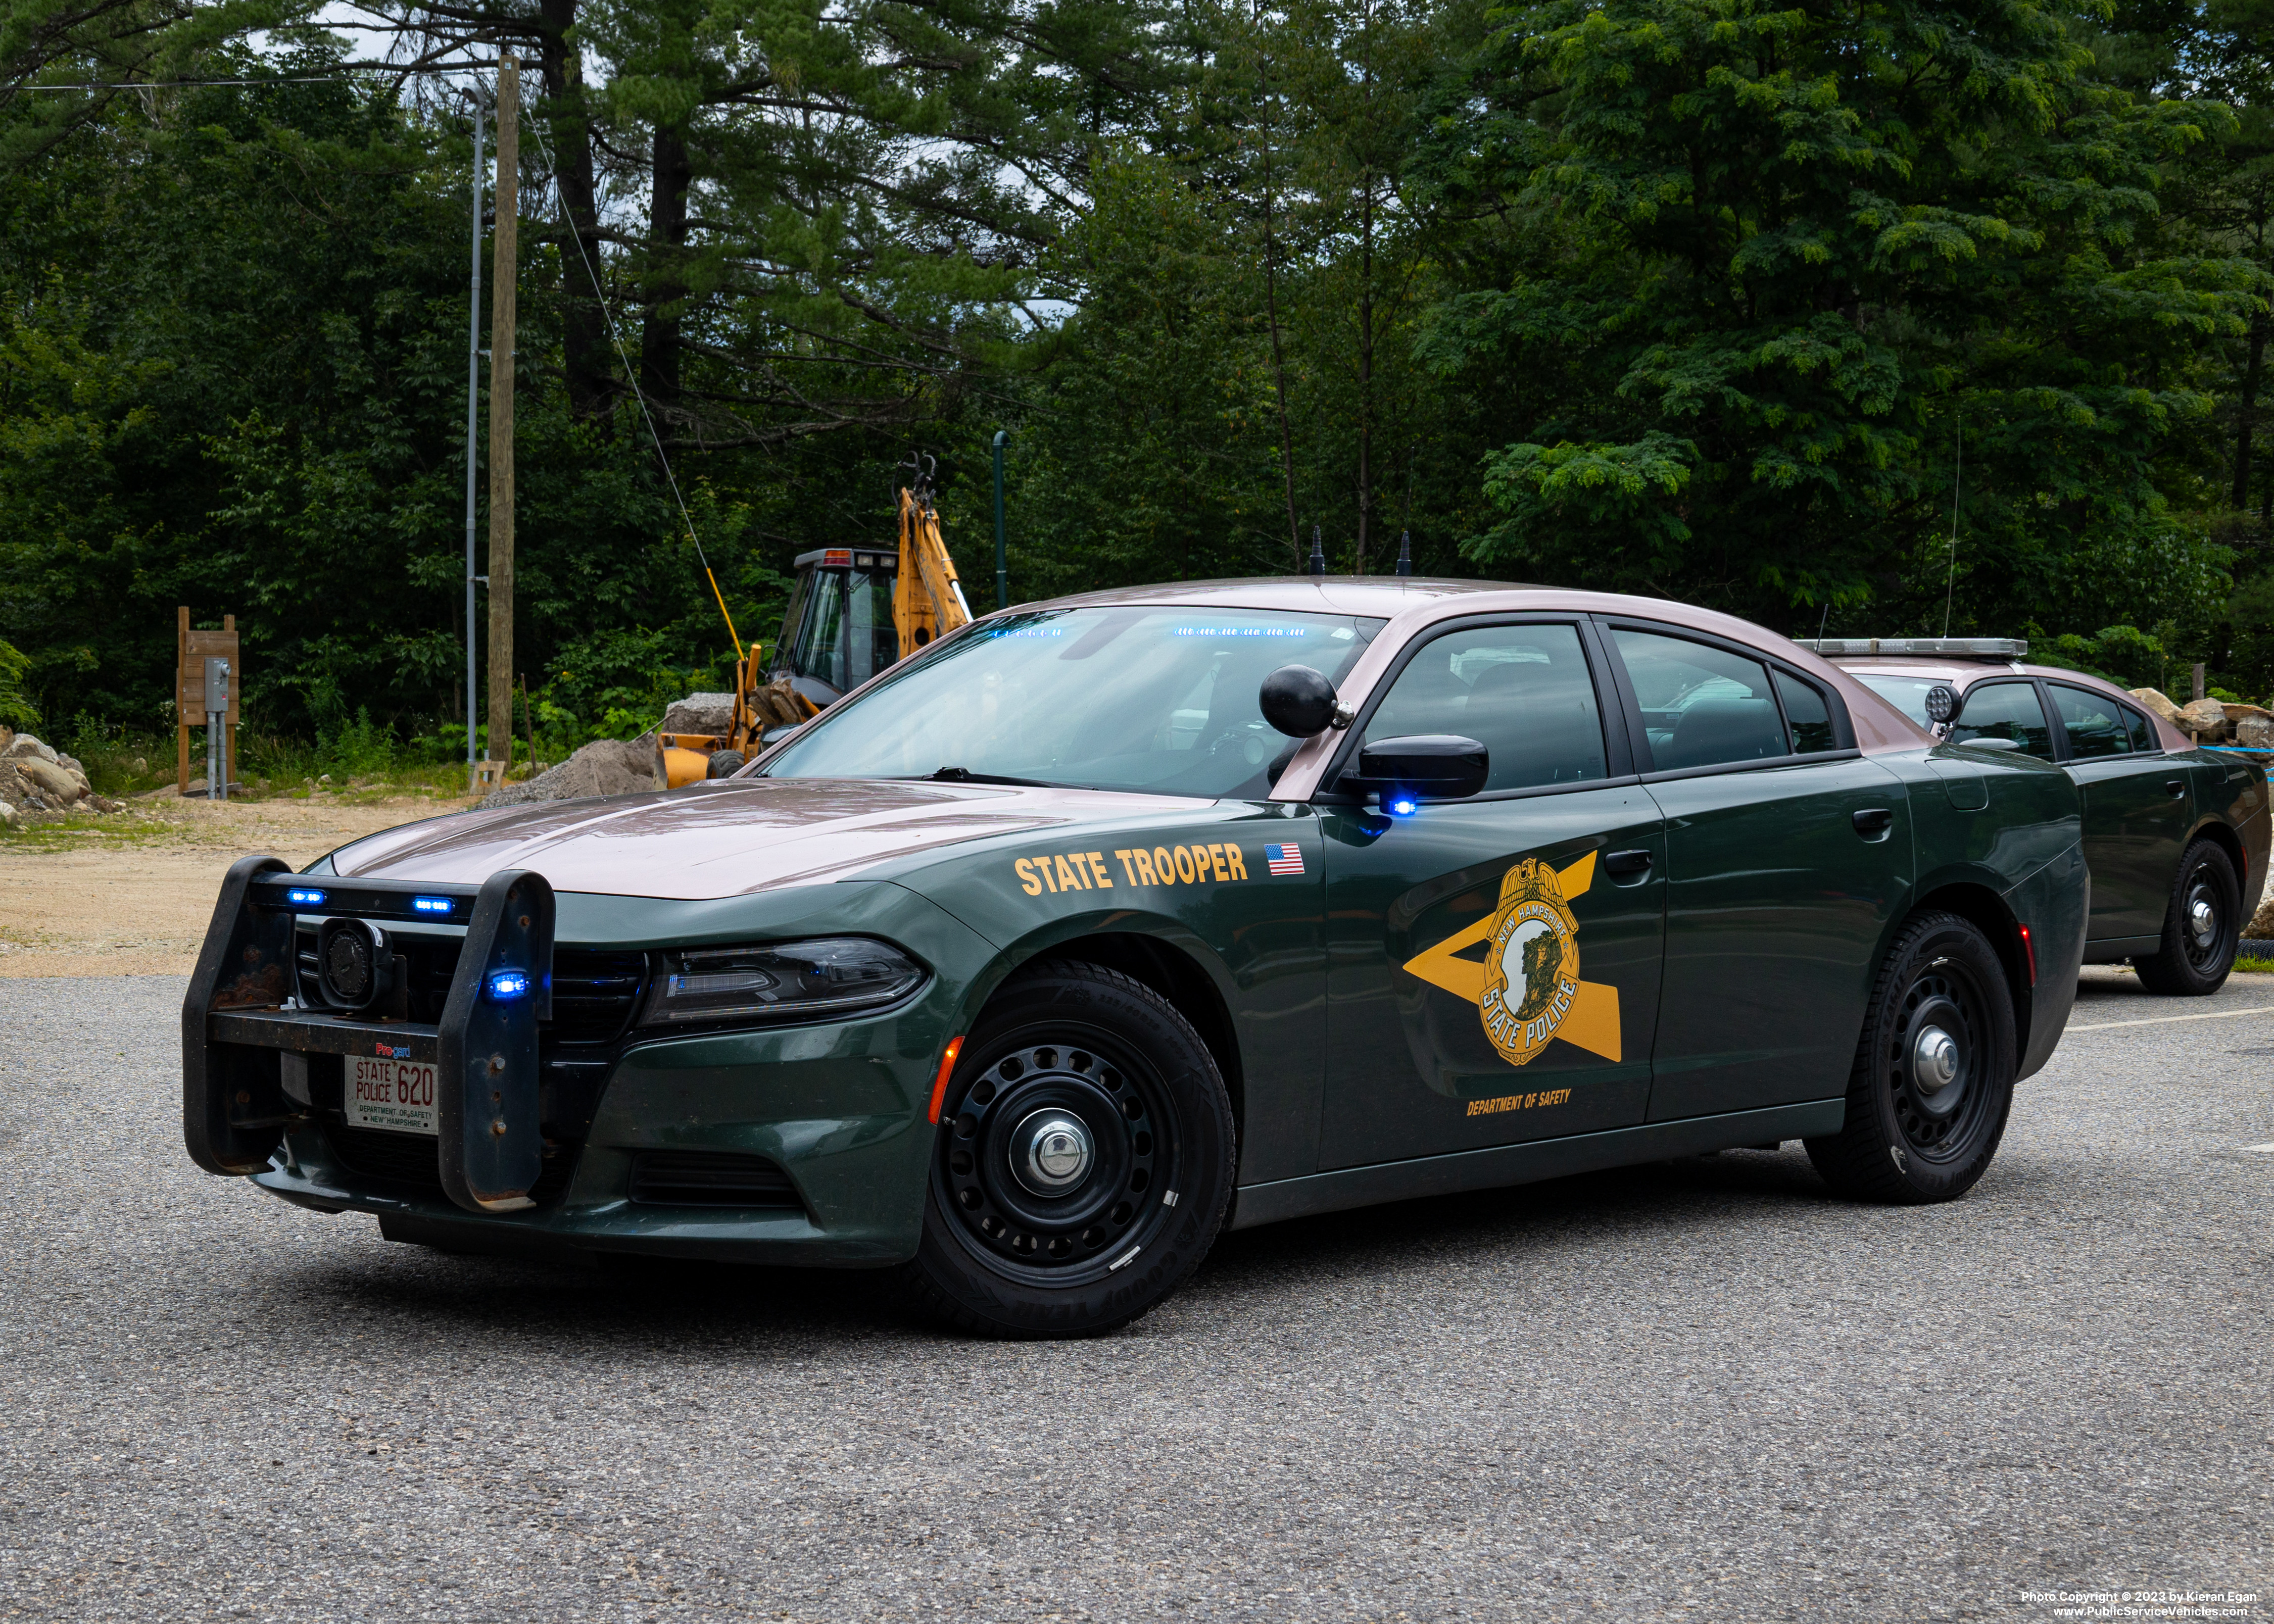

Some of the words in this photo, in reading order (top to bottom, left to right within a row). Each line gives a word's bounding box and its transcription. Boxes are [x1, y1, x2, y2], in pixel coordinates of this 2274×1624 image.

[1014, 851, 1114, 896] STATE
[1115, 843, 1248, 887] TROOPER
[1498, 916, 1516, 945] NEW
[1519, 904, 1567, 940] HAMPSHIRE
[1483, 988, 1521, 1049] STATE
[1526, 978, 1577, 1048] POLICE
[357, 1061, 391, 1082] STATE
[398, 1065, 433, 1106] 620
[356, 1081, 391, 1103] POLICE
[1467, 1095, 1523, 1116] DEPARTMENT
[1524, 1092, 1537, 1108] OF
[1538, 1088, 1571, 1107] SAFETY
[359, 1105, 397, 1115] DEPARTMENT
[410, 1111, 432, 1119] SAFETY
[386, 1118, 421, 1127] HAMPSHIRE
